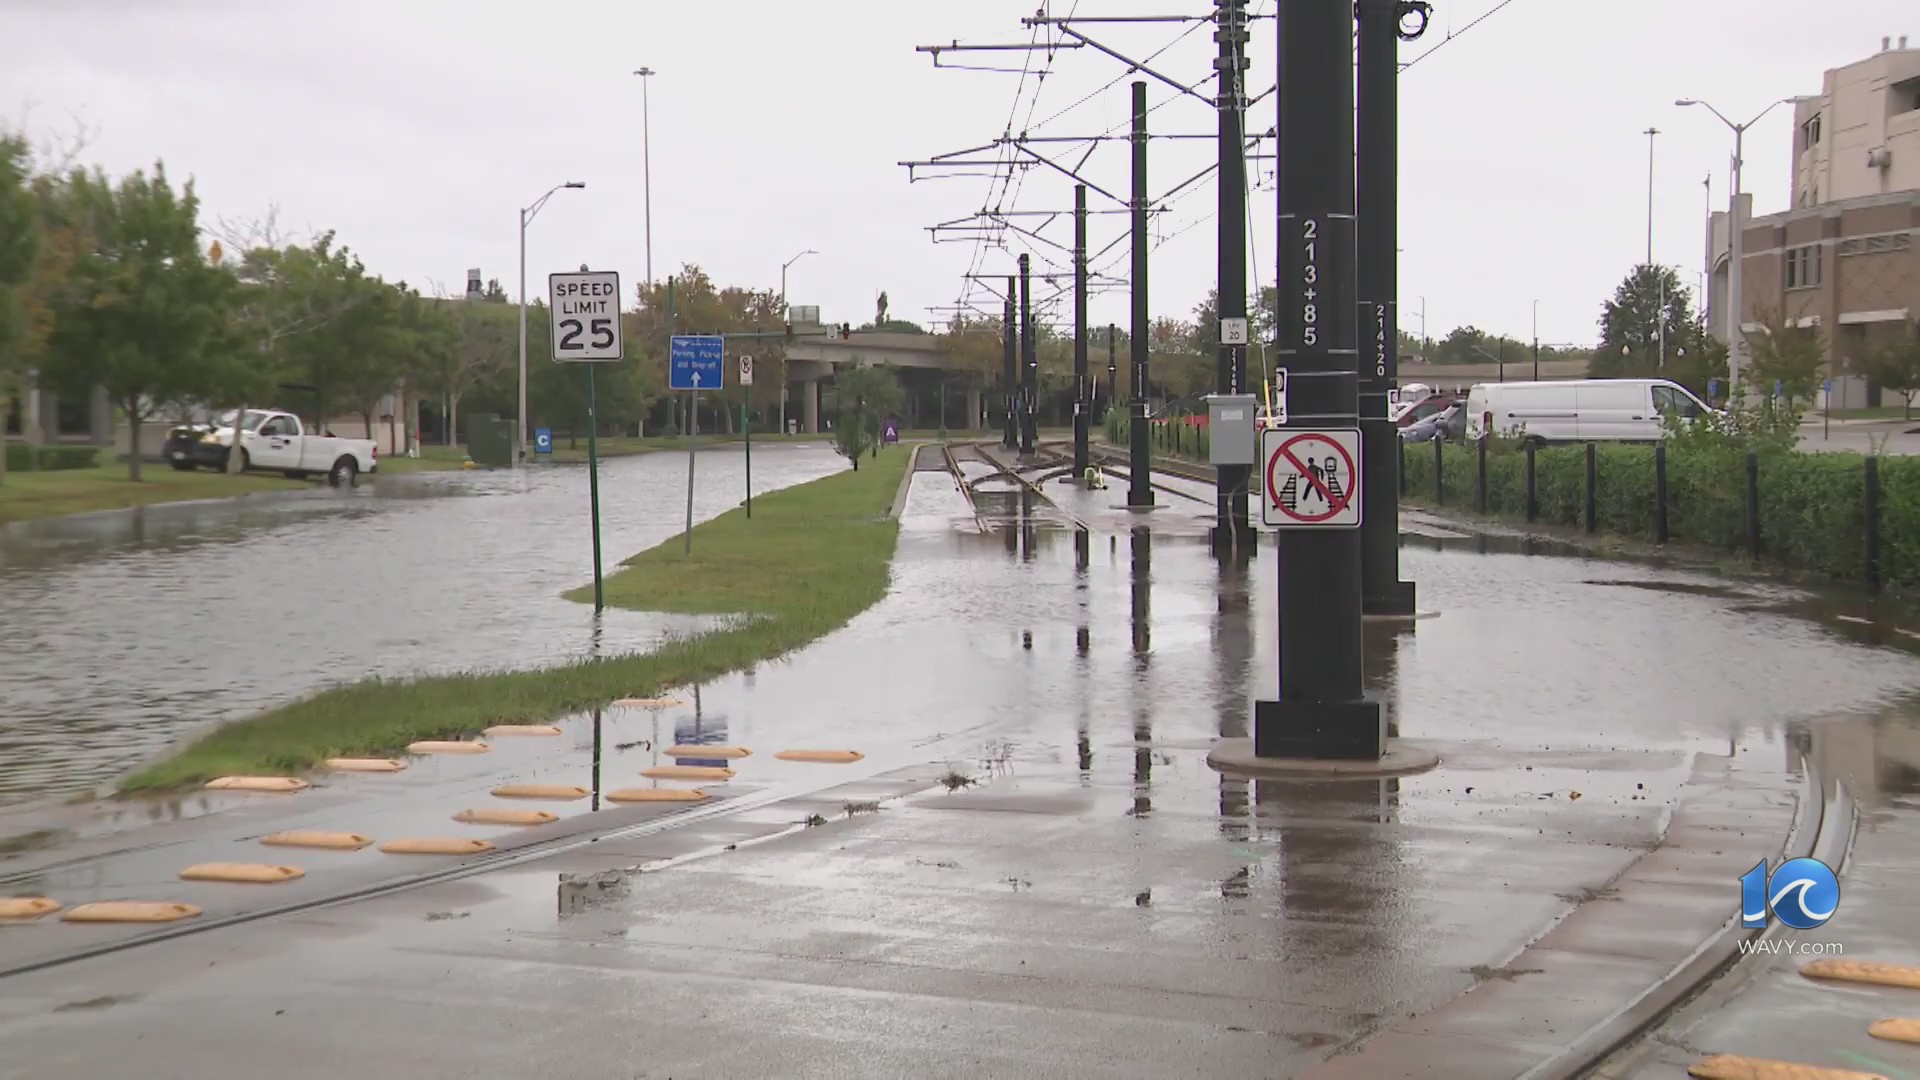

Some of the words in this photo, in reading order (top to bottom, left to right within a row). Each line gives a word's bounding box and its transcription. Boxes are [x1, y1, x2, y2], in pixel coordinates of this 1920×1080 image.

[556, 282, 614, 297] SPEED
[1302, 218, 1318, 346] 213+85
[563, 300, 607, 314] LIMIT
[559, 319, 615, 350] 25
[1376, 304, 1385, 377] 214+20
[885, 427, 896, 436] A
[537, 434, 549, 446] C
